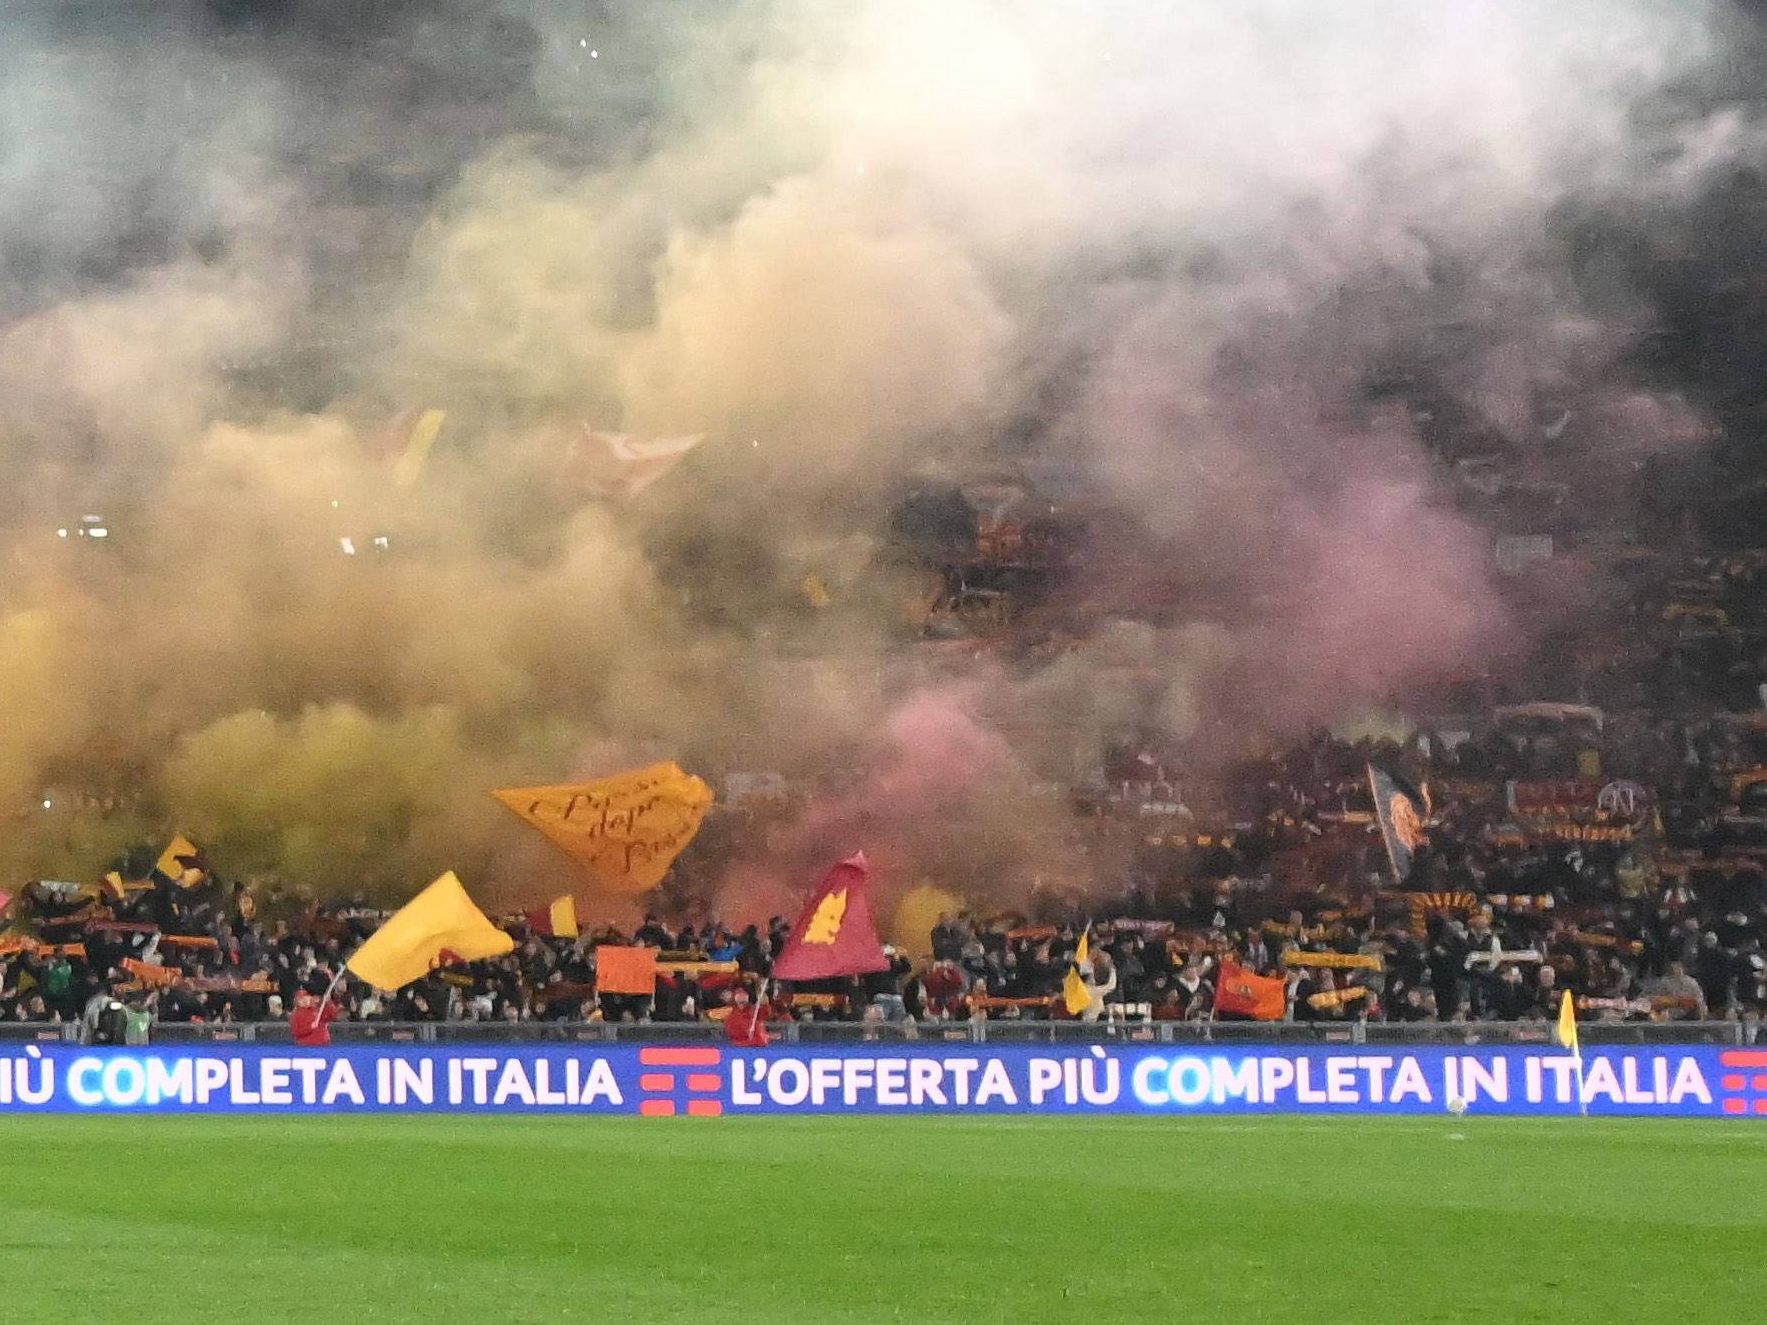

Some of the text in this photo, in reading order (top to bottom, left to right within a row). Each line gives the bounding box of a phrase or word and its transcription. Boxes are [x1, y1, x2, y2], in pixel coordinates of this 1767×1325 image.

[67, 1058, 364, 1105] COMPLETA
[378, 1058, 433, 1104] IN
[449, 1058, 623, 1105] ITALIA
[732, 1046, 1713, 1105] L'OFFERTA PIÙ COMPLETA IN ITALIA
